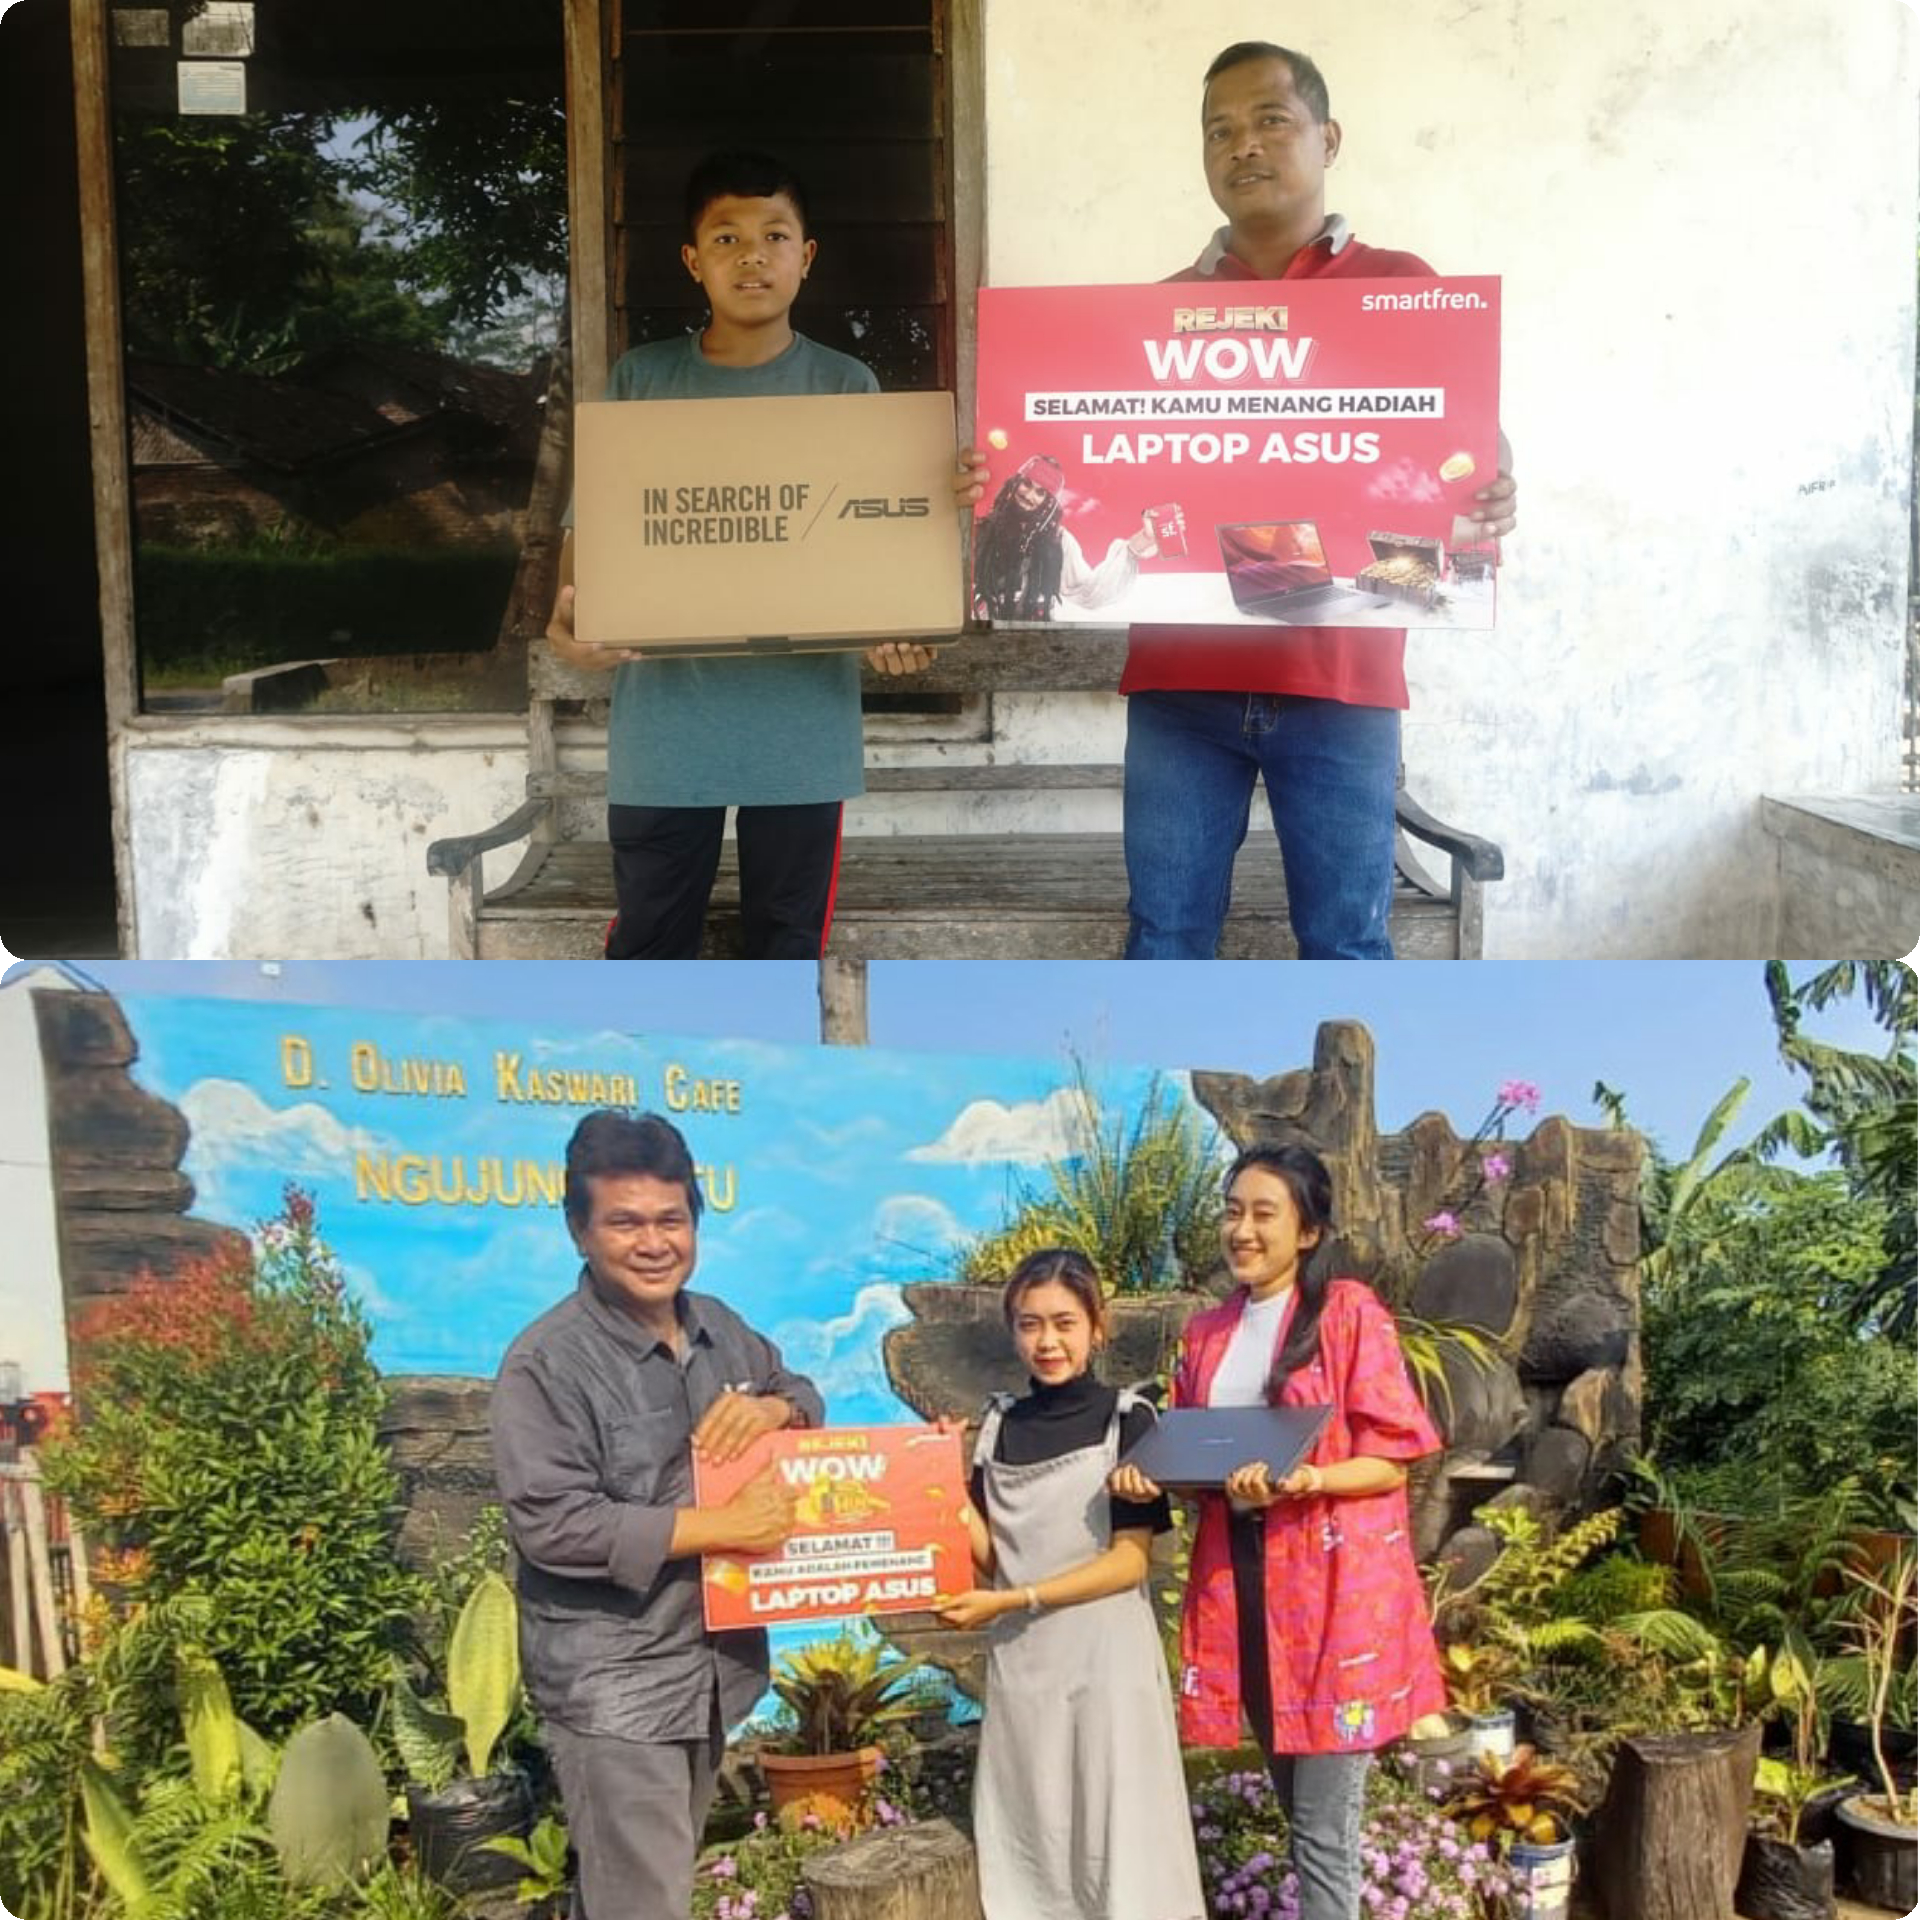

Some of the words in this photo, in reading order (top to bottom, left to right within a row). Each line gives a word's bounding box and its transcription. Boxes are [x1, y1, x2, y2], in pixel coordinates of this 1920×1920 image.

[1361, 287, 1488, 311] smartfren.
[1173, 306, 1289, 333] REJEKI
[1143, 337, 1315, 382] WOW
[1033, 398, 1146, 415] SELAMAT!
[1151, 397, 1222, 414] KAMU
[1227, 396, 1333, 413] MENANG
[1338, 395, 1436, 412] HADIAH
[1082, 432, 1250, 464] LAPTOP
[1258, 432, 1381, 463] ASUS
[643, 488, 668, 514] IN
[676, 485, 771, 513] SEARCH
[778, 484, 810, 511] OF
[837, 497, 930, 519] ASUS
[643, 516, 789, 546] INCREDIBLE
[280, 1034, 329, 1091] D.
[355, 1149, 567, 1208] NGUJUN
[780, 1454, 888, 1484] WOW
[787, 1538, 872, 1555] SELAMAT
[751, 1583, 860, 1613] LAPTOP
[865, 1577, 937, 1600] ASUS
